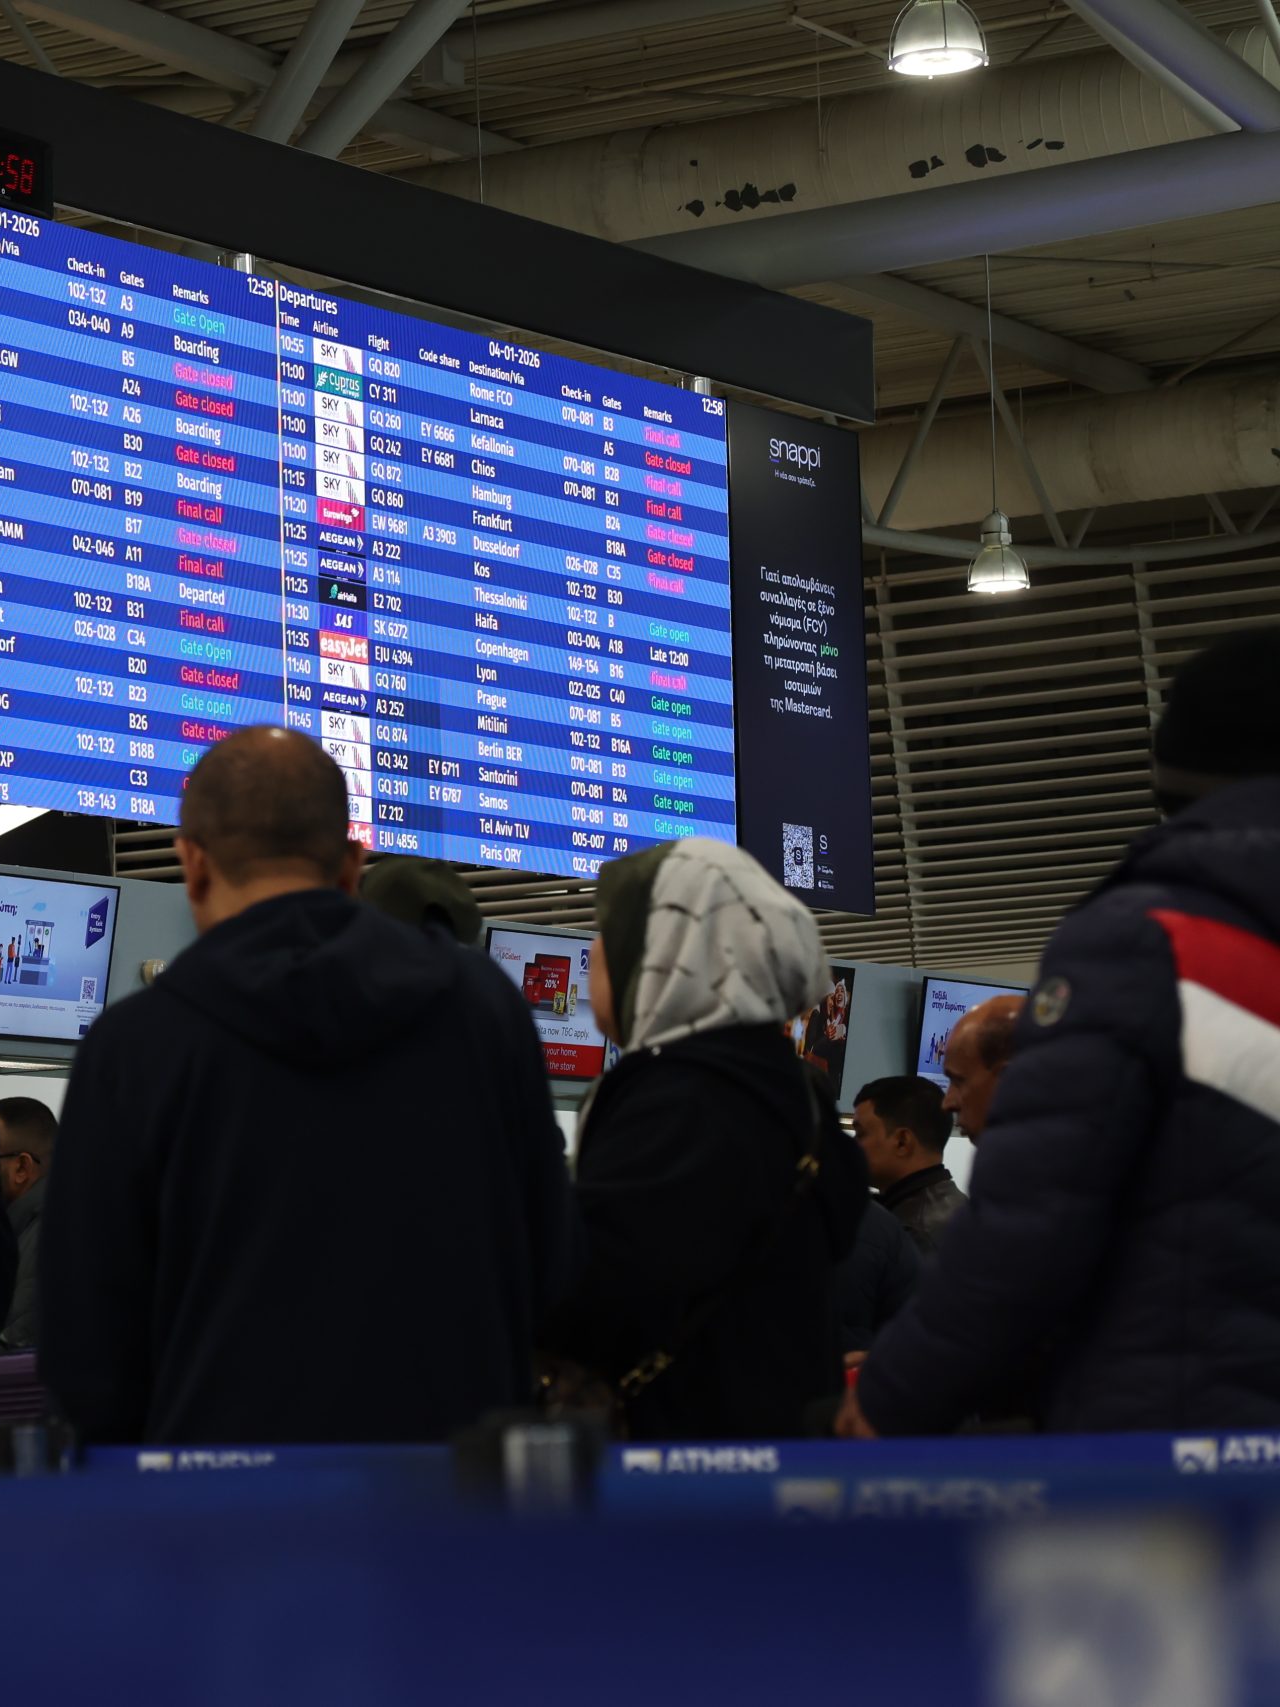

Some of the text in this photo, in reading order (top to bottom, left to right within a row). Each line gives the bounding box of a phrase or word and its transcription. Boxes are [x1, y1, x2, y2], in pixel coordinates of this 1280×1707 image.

[173, 285, 209, 304] Remarks
[247, 278, 274, 298] 12:58
[280, 286, 337, 314] Departures
[69, 310, 134, 338] 034-040 A9
[174, 336, 219, 364] Boarding
[489, 342, 540, 368] 04-01-2026
[281, 362, 304, 380] 11:00
[470, 361, 524, 385] Destination/Via
[330, 373, 396, 403] Cyprus CY 311
[644, 406, 672, 423] Remarks
[702, 398, 723, 416] 12:58
[471, 408, 504, 429] Larnaca
[604, 442, 614, 456] A5
[770, 438, 820, 471] snappi
[761, 566, 834, 598] Γιατί απολαμβάνεις
[180, 583, 225, 605] Departed
[760, 592, 834, 616] συναλλαγές σε ξένο
[334, 614, 352, 628] SAS
[770, 612, 827, 636] νόμισμα (FCY)
[320, 636, 412, 666] easyJet EJU 4394
[764, 631, 838, 657] πληρώνοντας μόνο
[650, 647, 688, 666] Late 12:00
[764, 655, 837, 678] τη μετατροπή βάσει
[477, 664, 496, 682] Lyon
[569, 681, 625, 704] 022-025 C40
[785, 680, 821, 696] ισοτιμιών
[652, 696, 691, 716] Gate open
[770, 697, 832, 718] της Mastercard.
[78, 791, 116, 810] 138-143
[131, 798, 155, 814] B18A
[820, 835, 827, 850] S
[481, 845, 521, 863] Paris ORY
[666, 1448, 779, 1474] ATHENS
